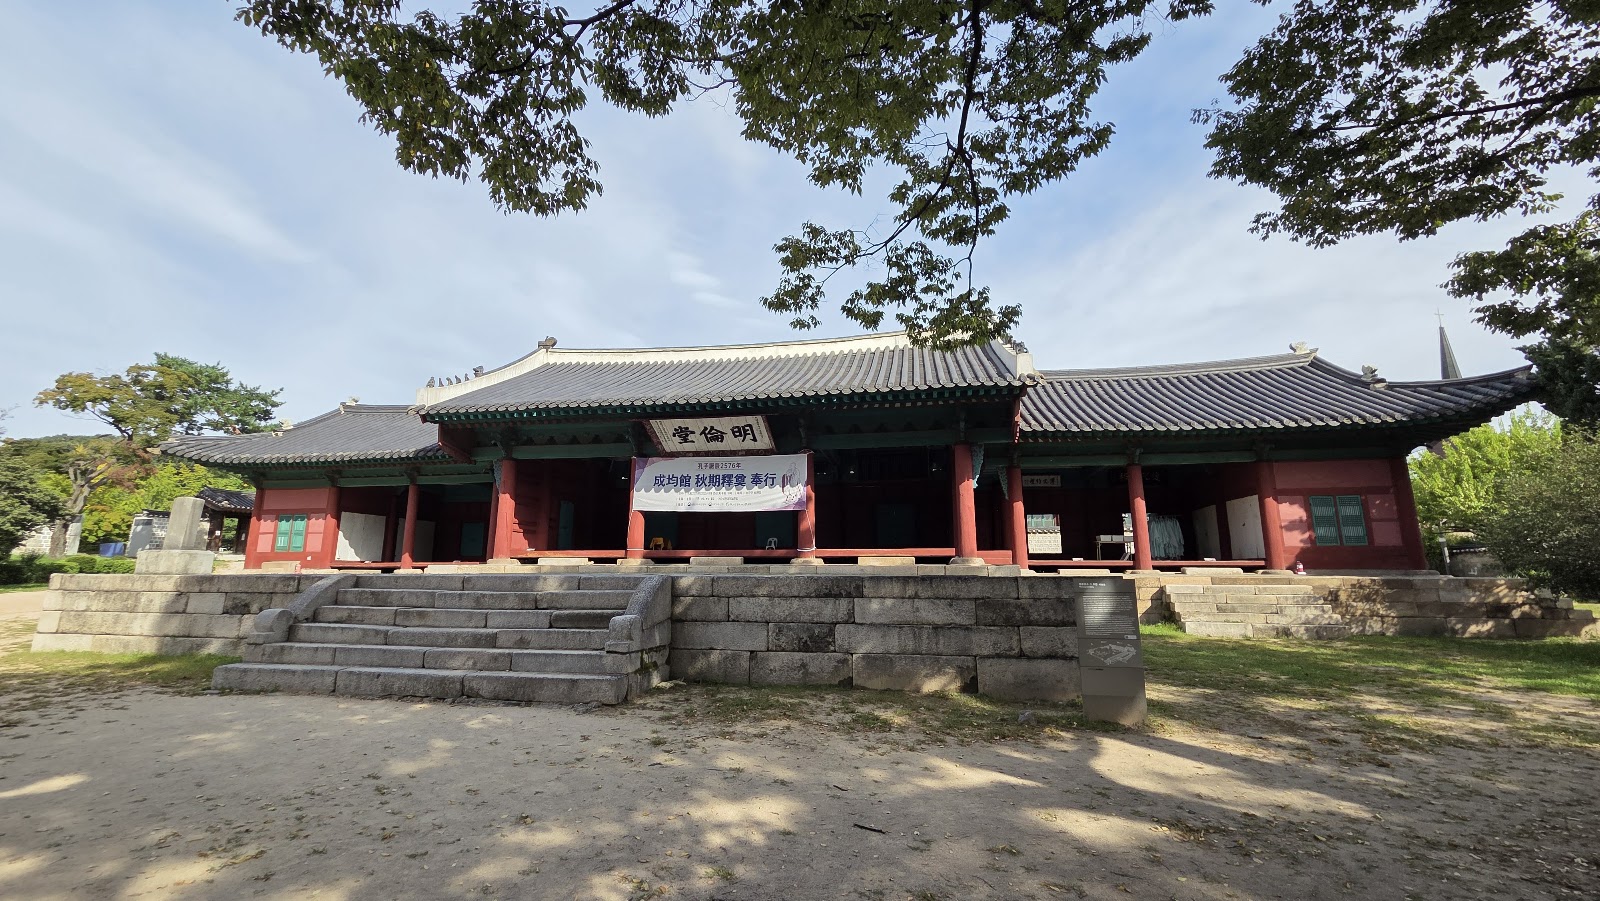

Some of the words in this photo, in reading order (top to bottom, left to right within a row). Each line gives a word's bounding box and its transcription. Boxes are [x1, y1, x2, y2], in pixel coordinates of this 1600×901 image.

[653, 474, 691, 488] 成均館
[695, 474, 747, 488] 秋期釋奠
[750, 473, 777, 487] 奉行
